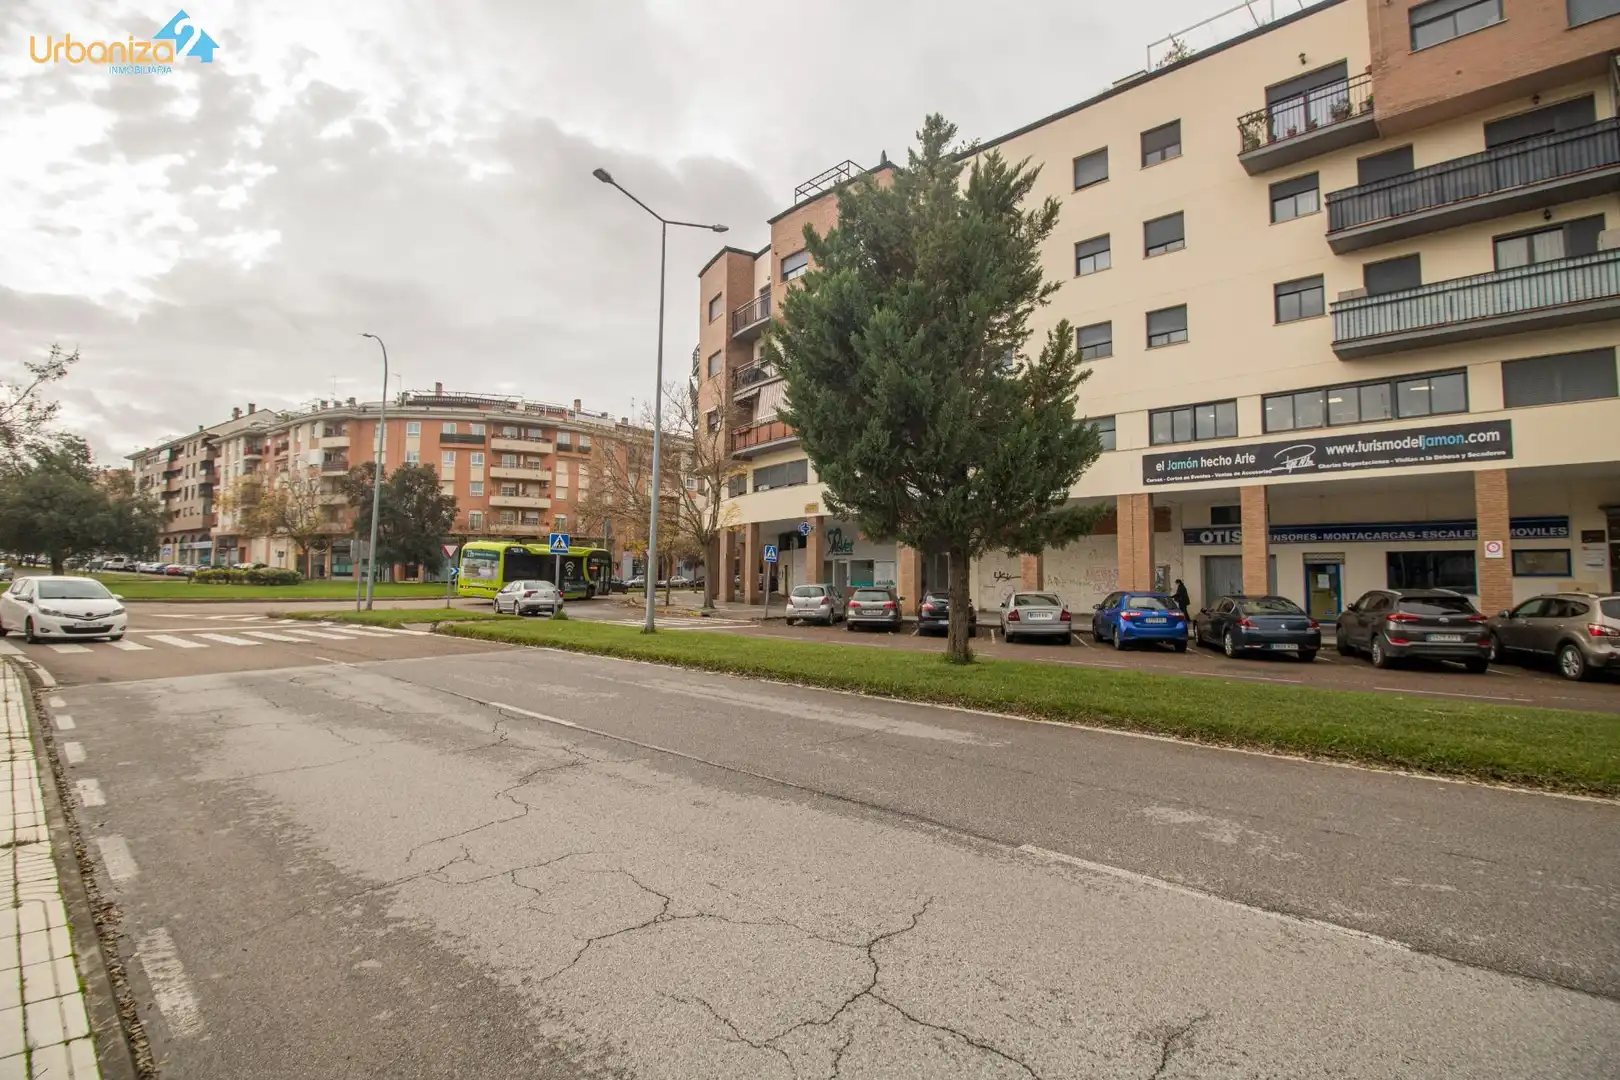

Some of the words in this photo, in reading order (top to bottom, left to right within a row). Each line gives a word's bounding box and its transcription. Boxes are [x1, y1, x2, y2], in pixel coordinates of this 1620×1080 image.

[1325, 430, 1500, 455] www.turismodeljamon.com
[1156, 461, 1164, 472] el
[1167, 457, 1198, 471] Jamón
[1201, 455, 1231, 468] hecho
[1234, 452, 1256, 465] Arte
[1200, 530, 1242, 544] OTIS
